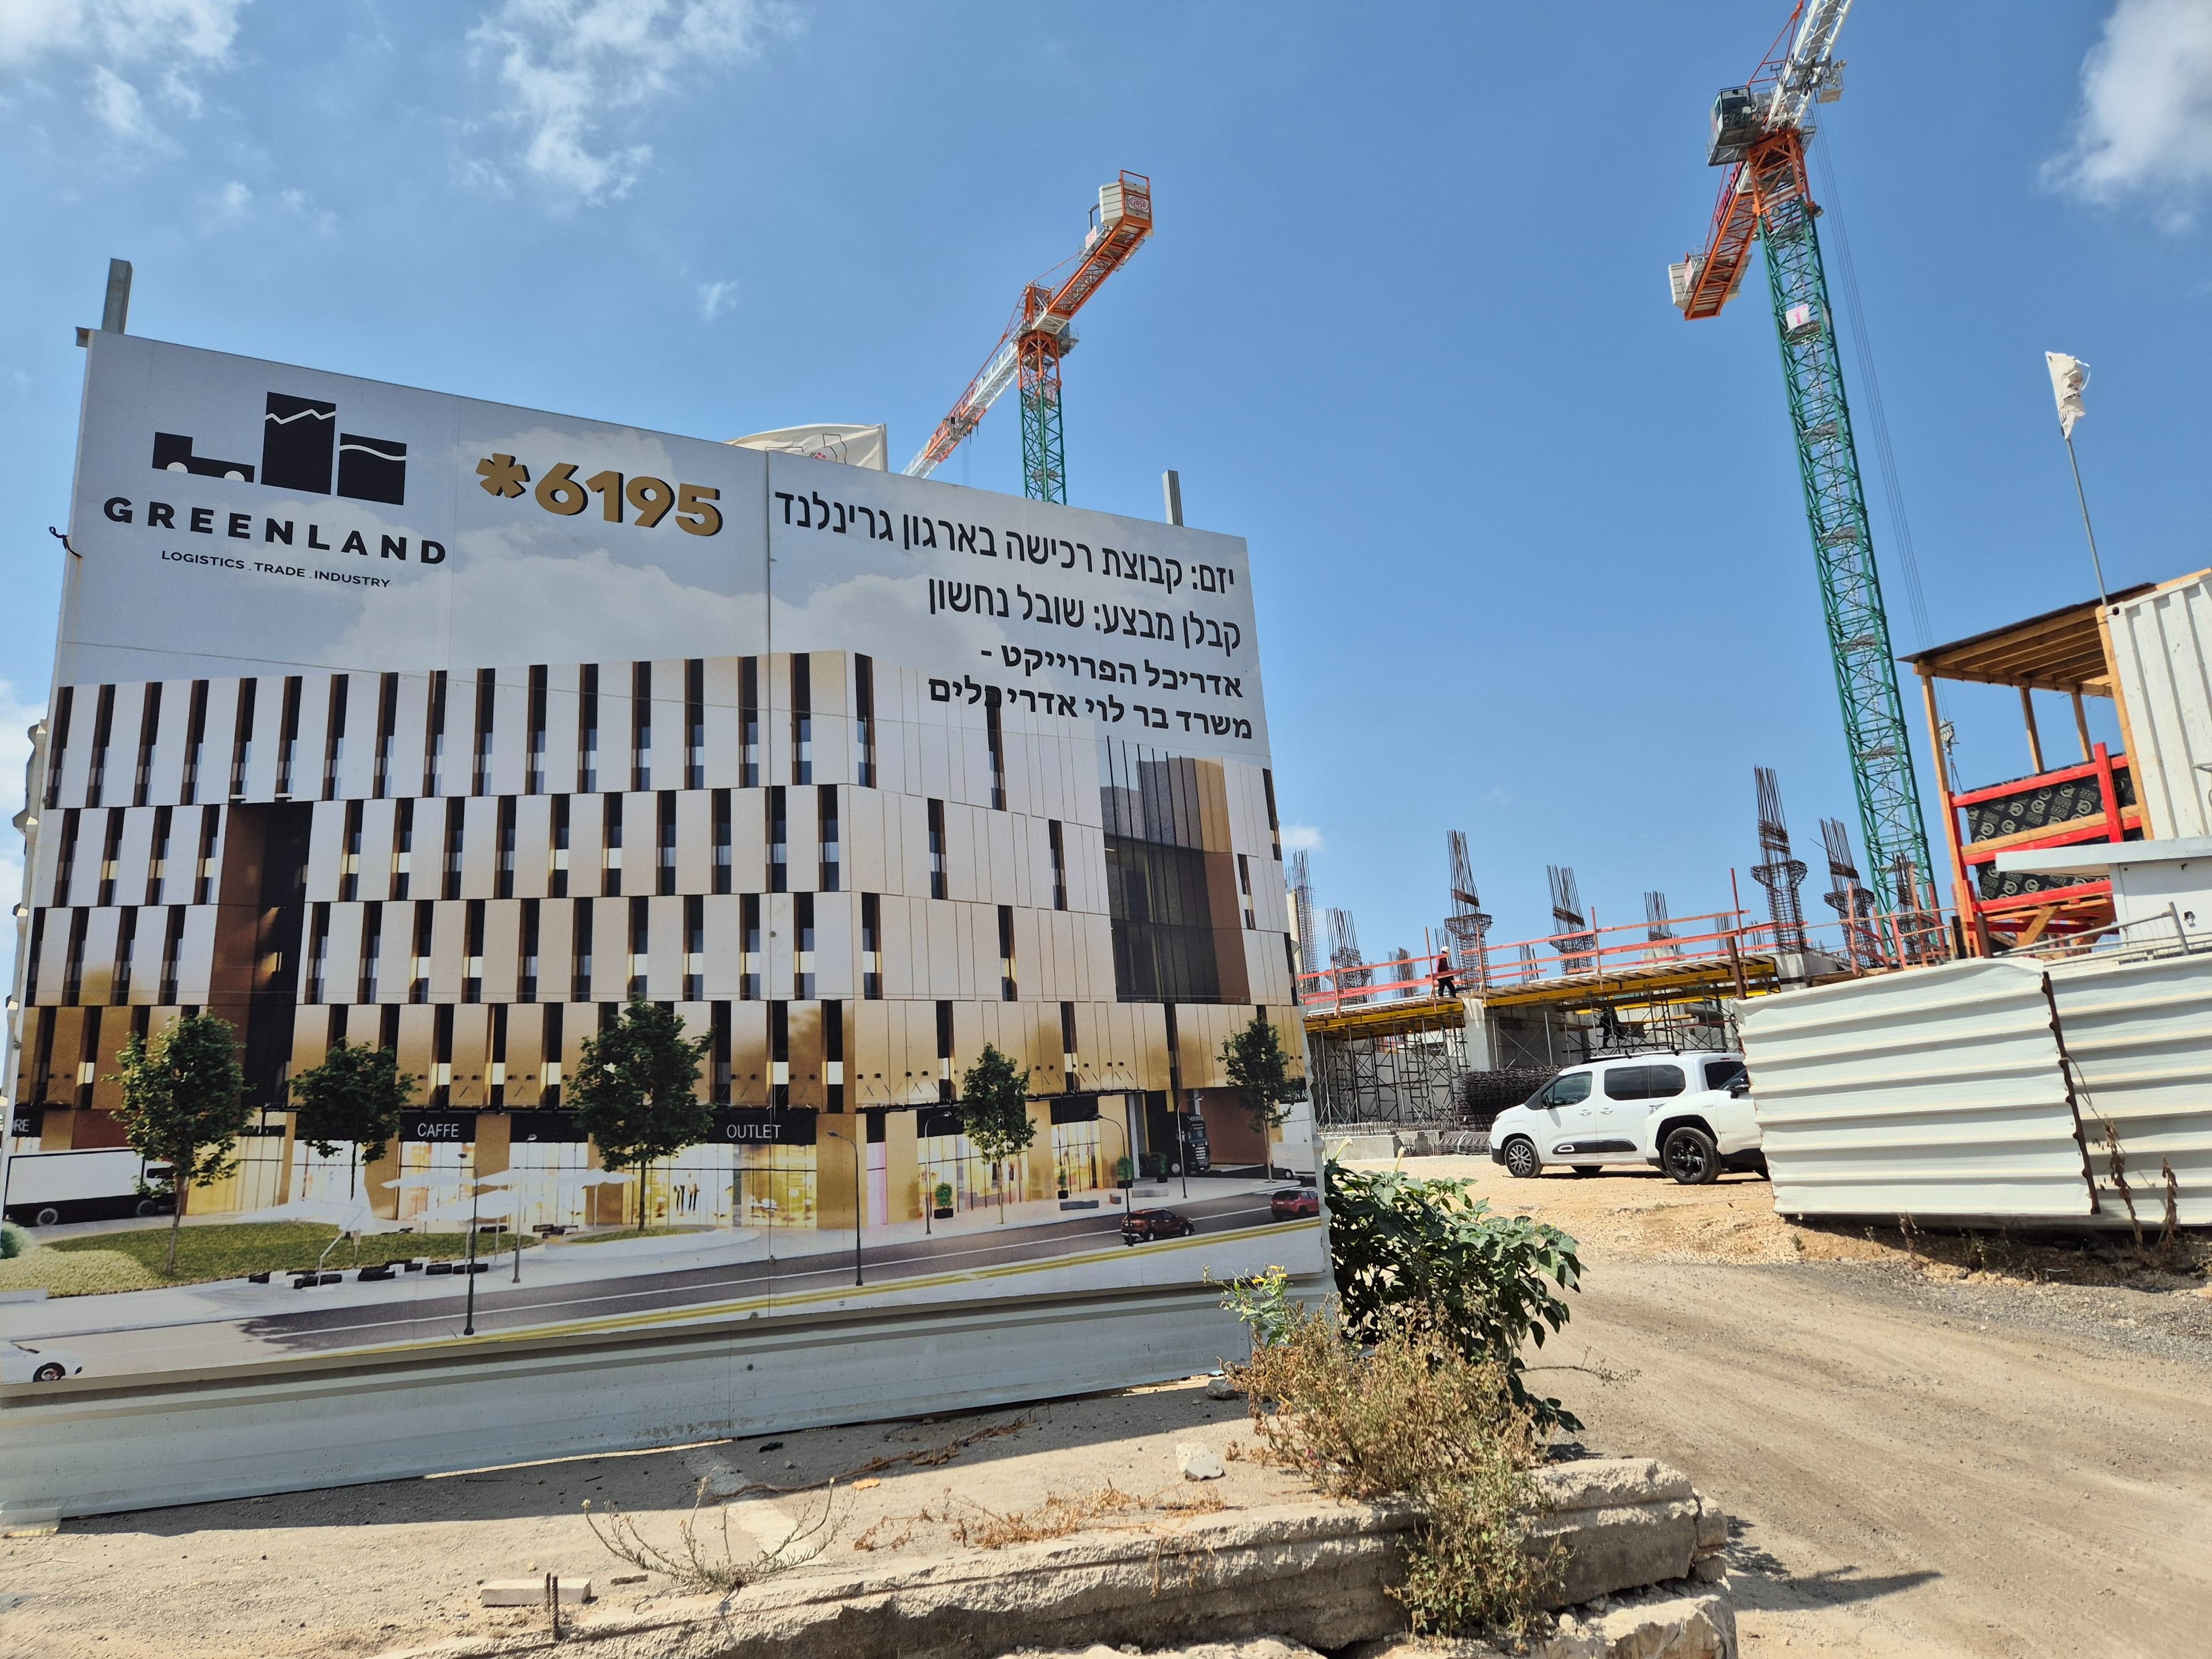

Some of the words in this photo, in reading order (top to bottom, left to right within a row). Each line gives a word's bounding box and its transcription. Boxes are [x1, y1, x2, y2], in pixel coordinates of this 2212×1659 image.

[1794, 311, 1801, 324] 1
[104, 497, 446, 565] GREENLAND
[775, 491, 893, 541] גרינלנד
[903, 514, 997, 557] בארגון
[1006, 531, 1092, 573] רכישה
[162, 550, 245, 569] LOGISTICS
[1102, 547, 1182, 594] קבוצת
[929, 578, 1009, 618] נחשון
[1191, 564, 1234, 594] יזם:
[1017, 584, 1084, 627] שובל
[1094, 604, 1175, 641] מבצע:
[1183, 611, 1240, 657] קבלן
[1001, 645, 1137, 685] הפרוייקט
[1144, 659, 1243, 698] אדריכל
[1085, 694, 1124, 722] לוי
[1133, 704, 1169, 729] בר
[1176, 710, 1252, 739] משרד
[13, 1119, 31, 1132] RE
[417, 1123, 460, 1138] CAFFE
[726, 1124, 782, 1139] OUTLET
